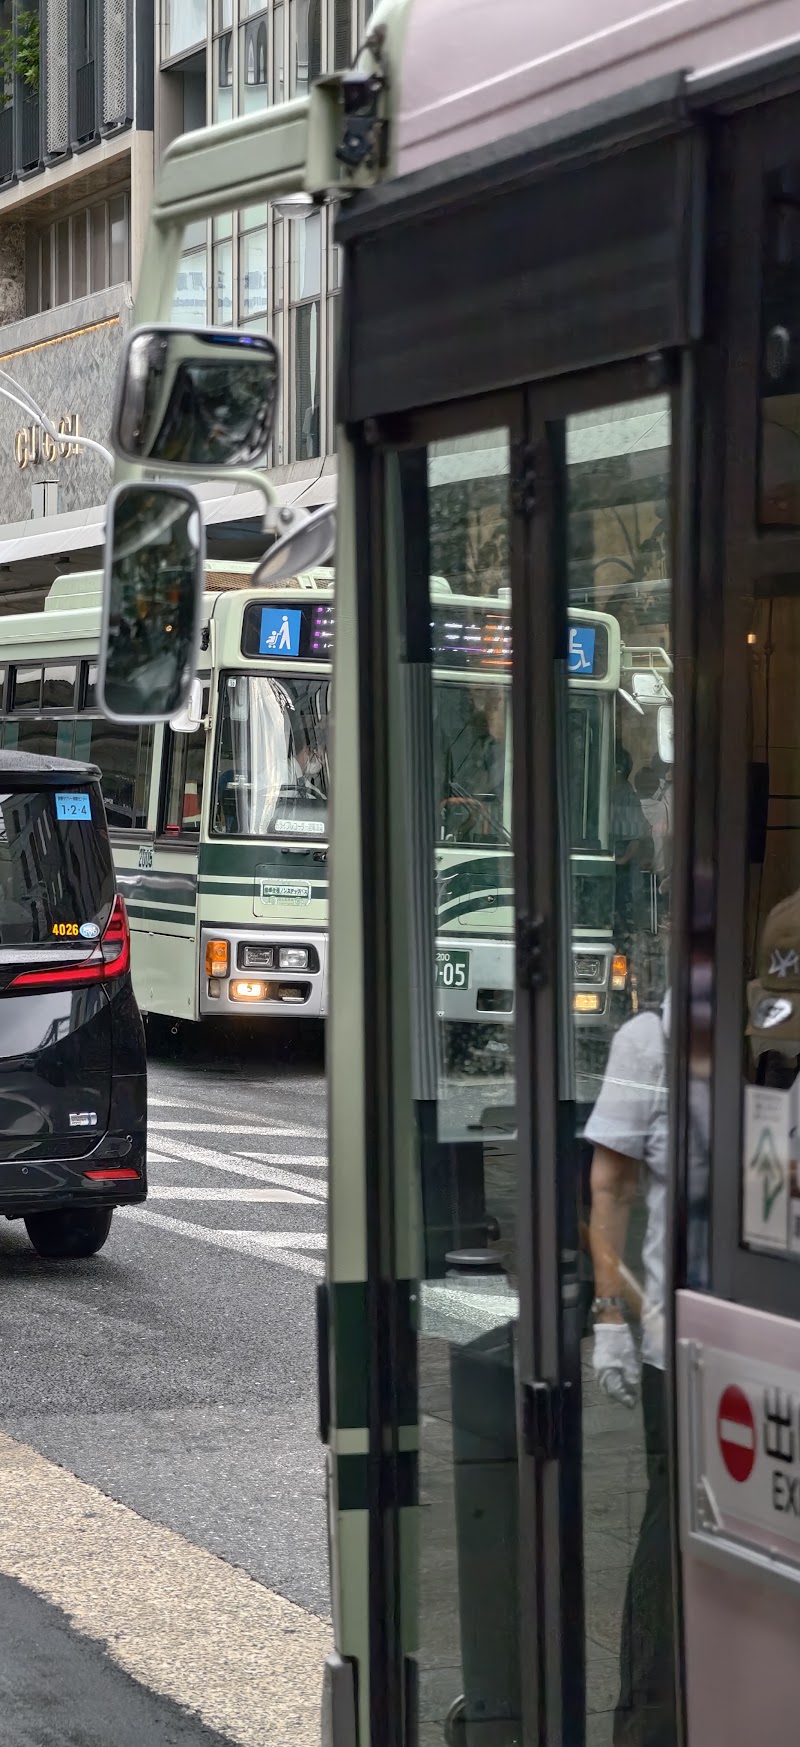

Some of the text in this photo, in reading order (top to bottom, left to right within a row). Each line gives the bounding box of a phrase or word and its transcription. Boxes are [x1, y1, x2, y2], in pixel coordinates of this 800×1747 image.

[14, 414, 82, 469] GUCCI
[52, 923, 79, 936] 4026
[434, 962, 466, 986] -05
[435, 952, 450, 961] 200
[764, 1386, 800, 1463] 出
[773, 1470, 800, 1518] EX
